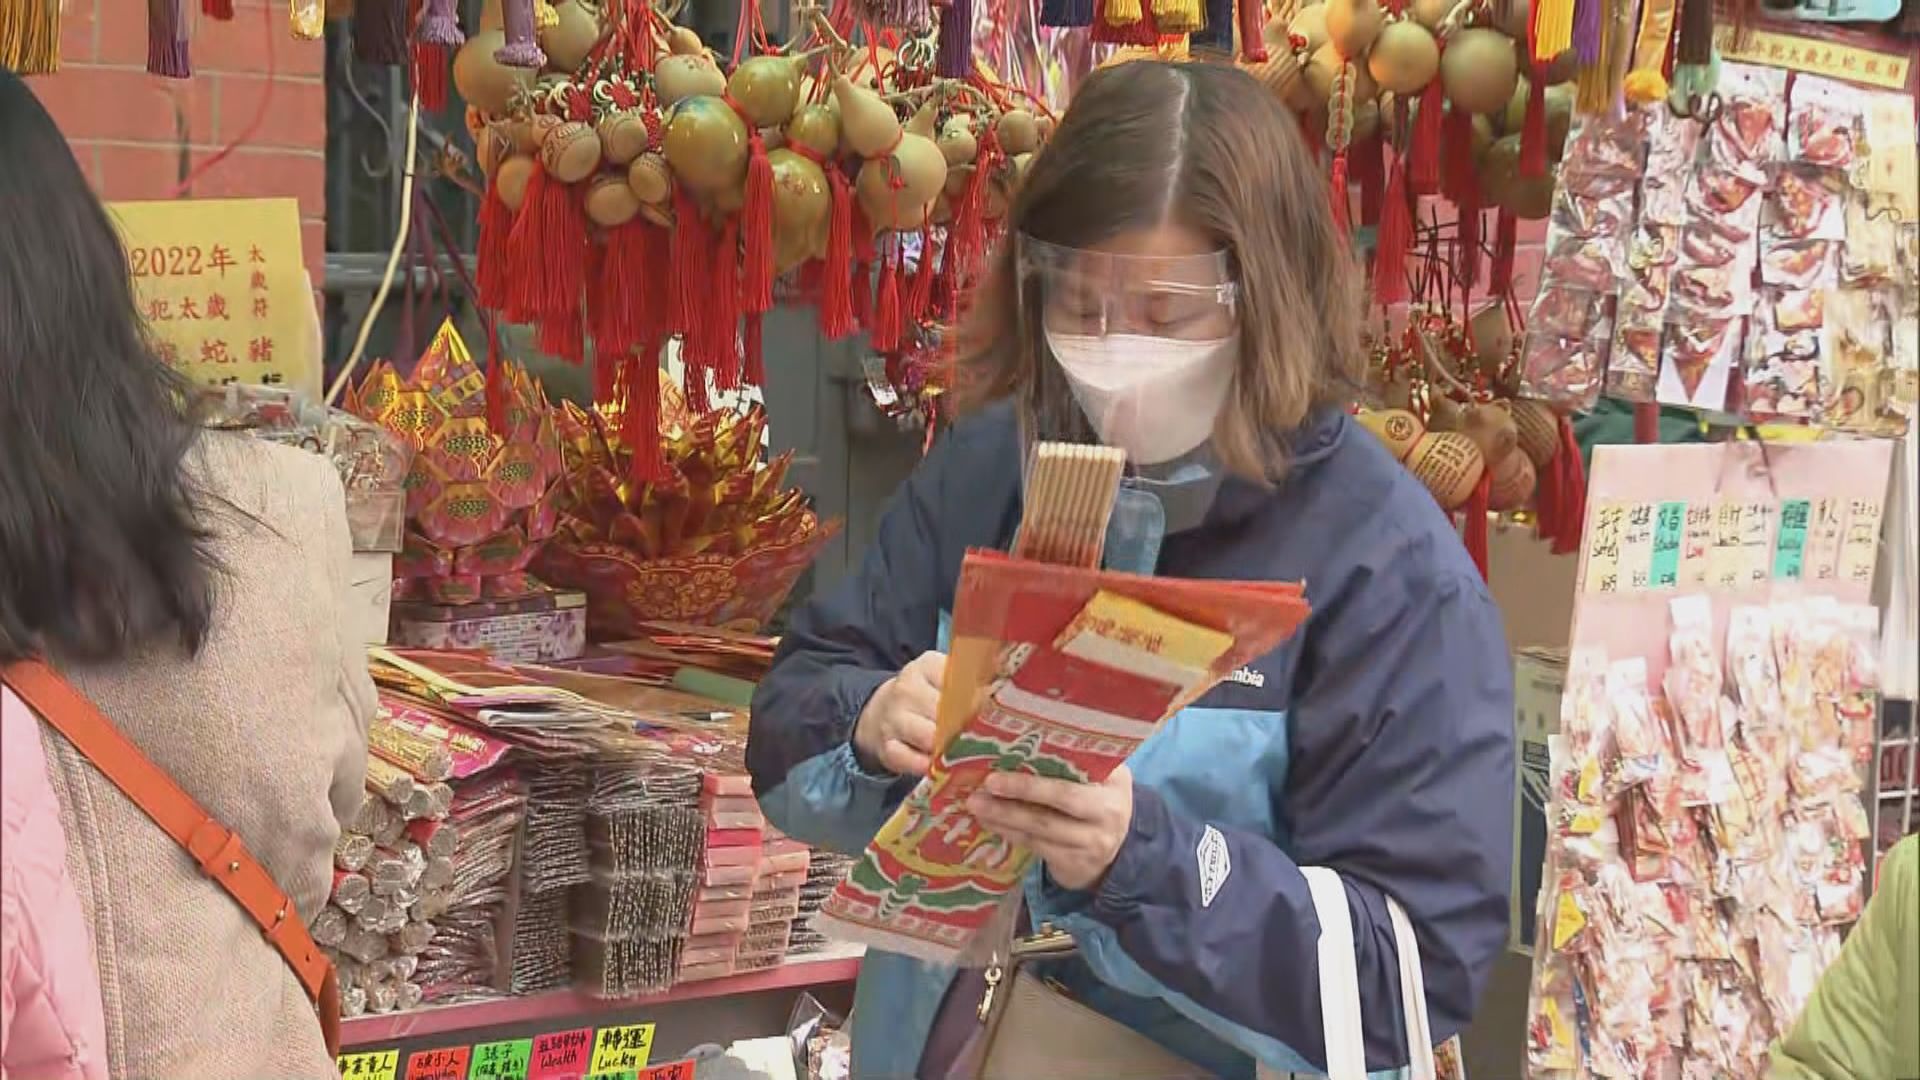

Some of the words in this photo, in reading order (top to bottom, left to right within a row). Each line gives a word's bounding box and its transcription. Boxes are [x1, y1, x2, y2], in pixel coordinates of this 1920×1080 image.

[131, 244, 237, 278] 2022年
[248, 244, 269, 319] 太歲符
[150, 293, 230, 321] 犯太歲
[600, 1027, 647, 1051] 轉運
[416, 1050, 459, 1068] 破小人
[541, 1048, 576, 1069] Wealth
[598, 1052, 637, 1070] Lucky
